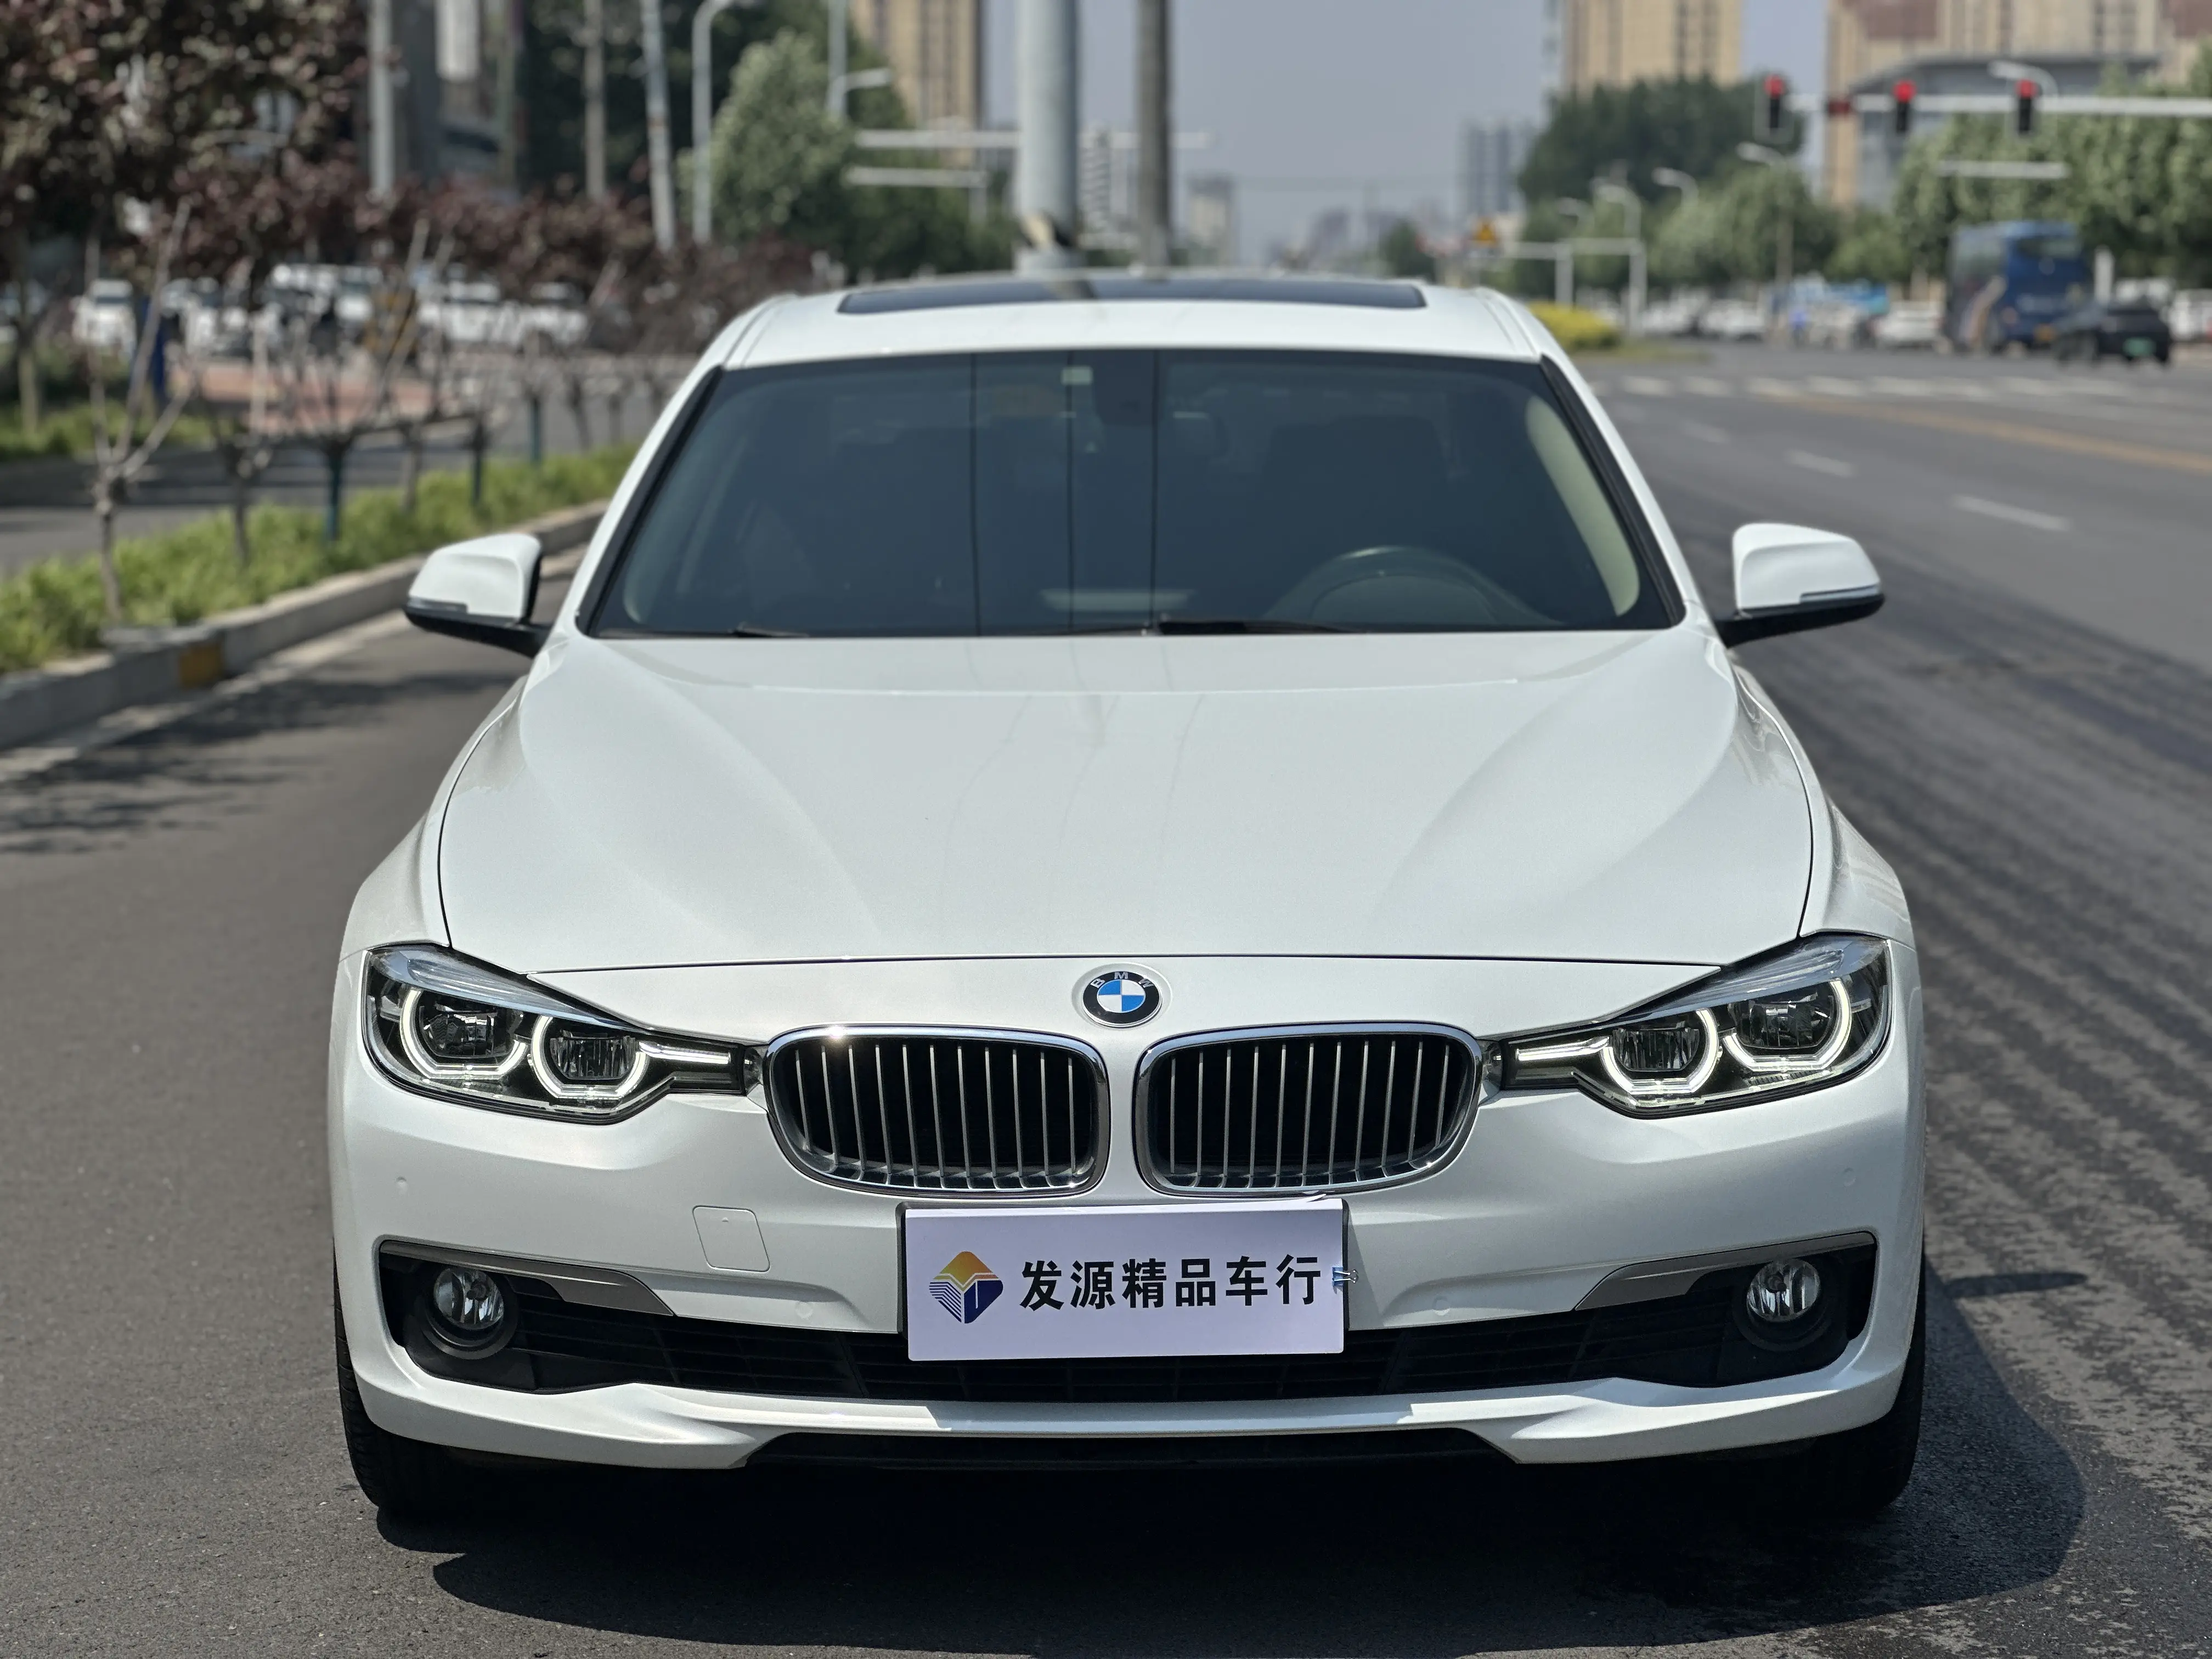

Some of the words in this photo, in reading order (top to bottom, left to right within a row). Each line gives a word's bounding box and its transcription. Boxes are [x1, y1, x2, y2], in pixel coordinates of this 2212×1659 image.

[1091, 971, 1155, 988] BMW
[1019, 1254, 1321, 1311] 发源精品车行
